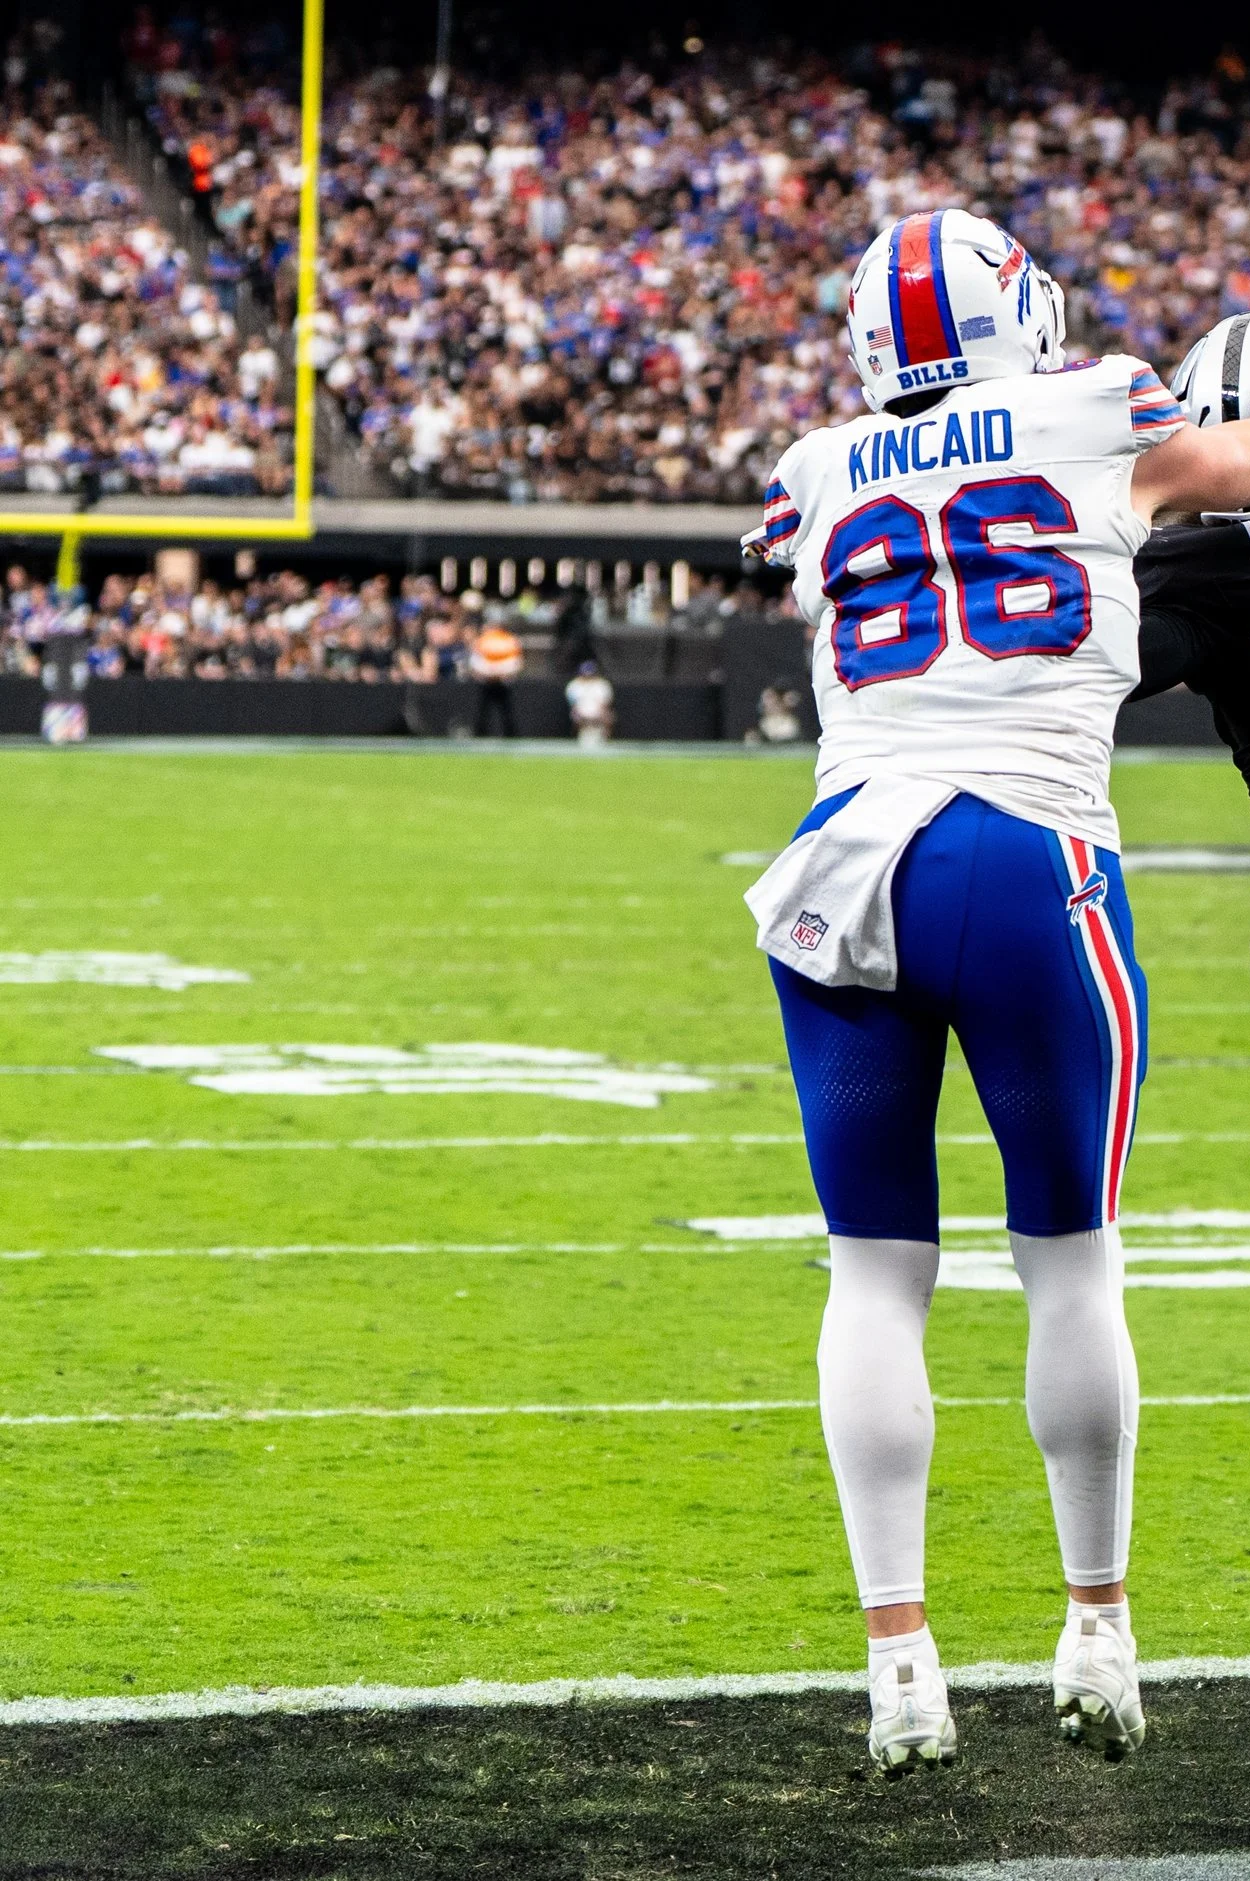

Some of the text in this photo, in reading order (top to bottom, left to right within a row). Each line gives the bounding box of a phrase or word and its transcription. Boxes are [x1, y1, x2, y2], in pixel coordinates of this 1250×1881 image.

[896, 360, 969, 390] BILLS
[849, 408, 1013, 492] KINCAID
[820, 475, 1092, 693] 86
[794, 924, 817, 947] NFL
